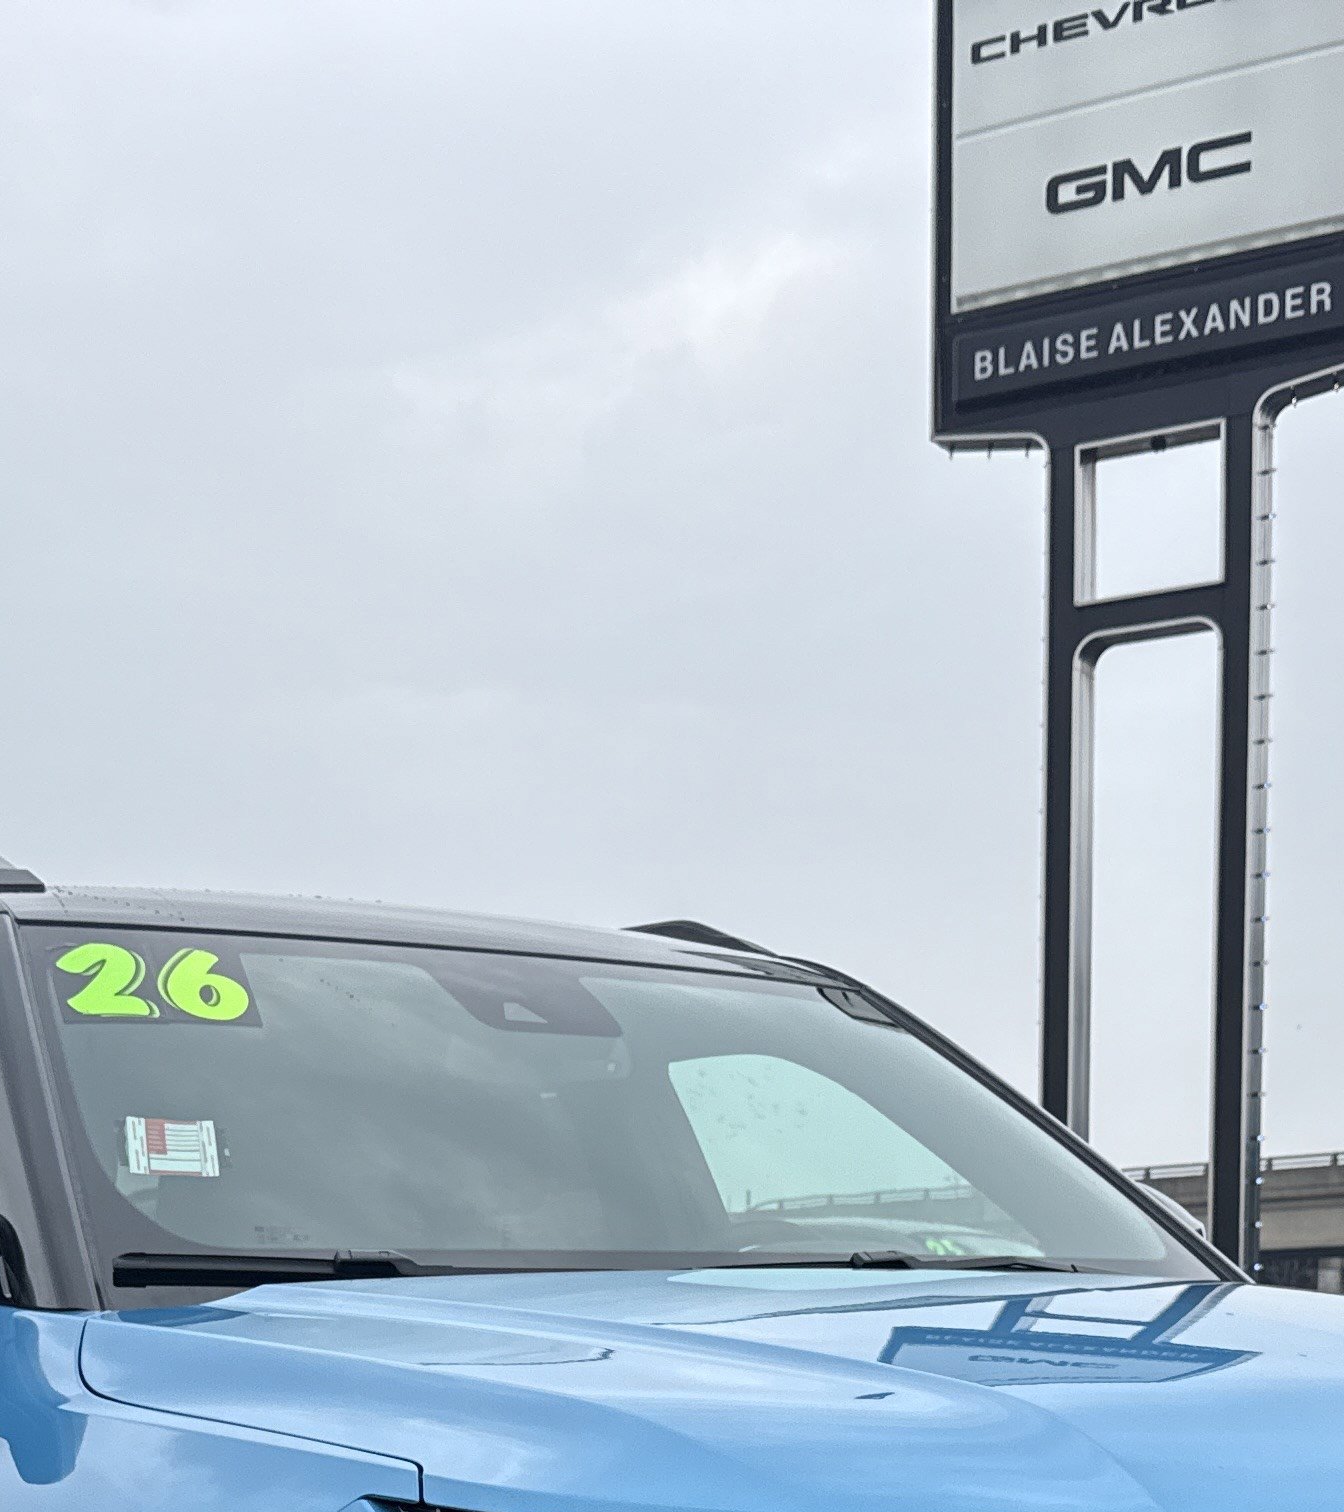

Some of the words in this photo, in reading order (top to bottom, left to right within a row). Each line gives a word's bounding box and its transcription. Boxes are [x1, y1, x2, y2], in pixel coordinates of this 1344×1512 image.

[1045, 131, 1252, 214] GMC
[973, 327, 1099, 381] BLAISE
[1107, 281, 1332, 354] ALEXANDER
[56, 943, 249, 1021] 26
